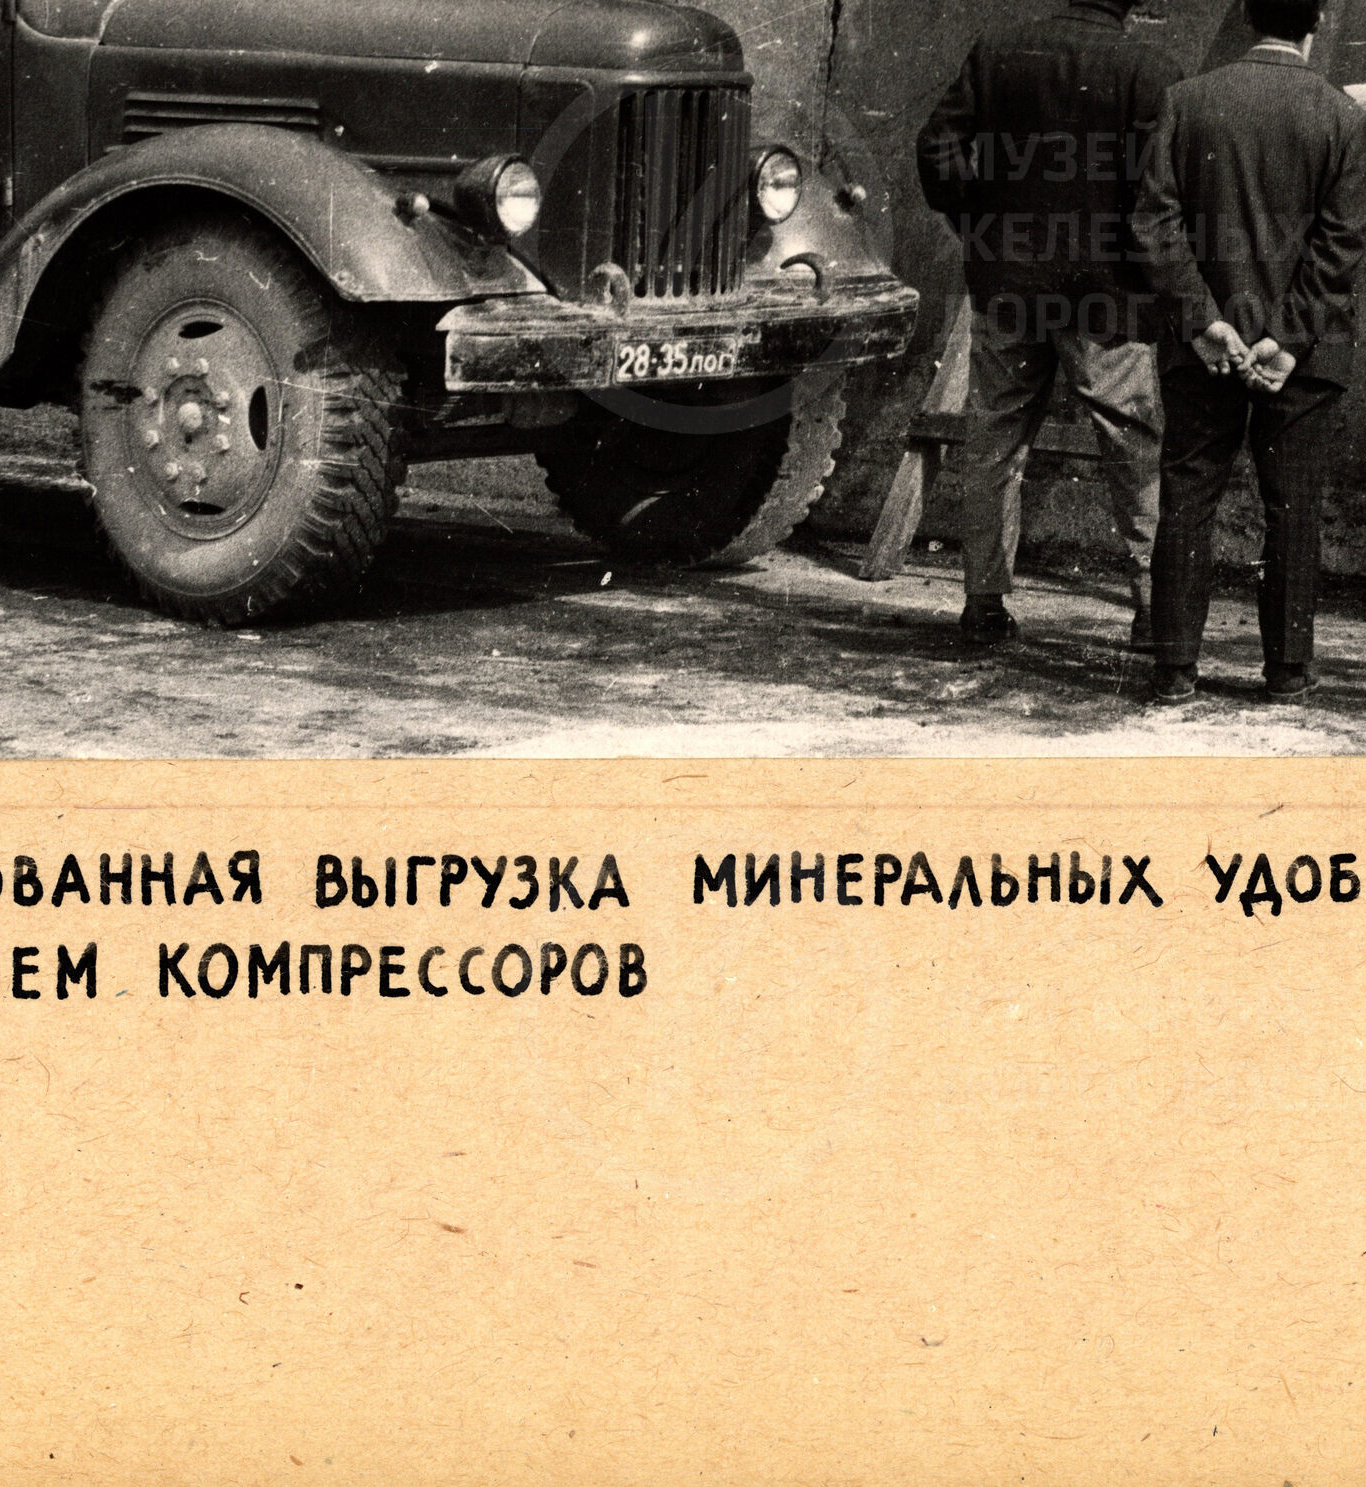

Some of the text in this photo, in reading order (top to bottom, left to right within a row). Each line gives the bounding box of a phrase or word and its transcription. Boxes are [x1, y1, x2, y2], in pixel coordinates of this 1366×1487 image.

[315, 853, 630, 913] ВЫГРУЗКА
[693, 851, 1164, 910] МИНЕРАЛЬНЫХ
[158, 941, 648, 1000] КОМПРЕССОРОВ
